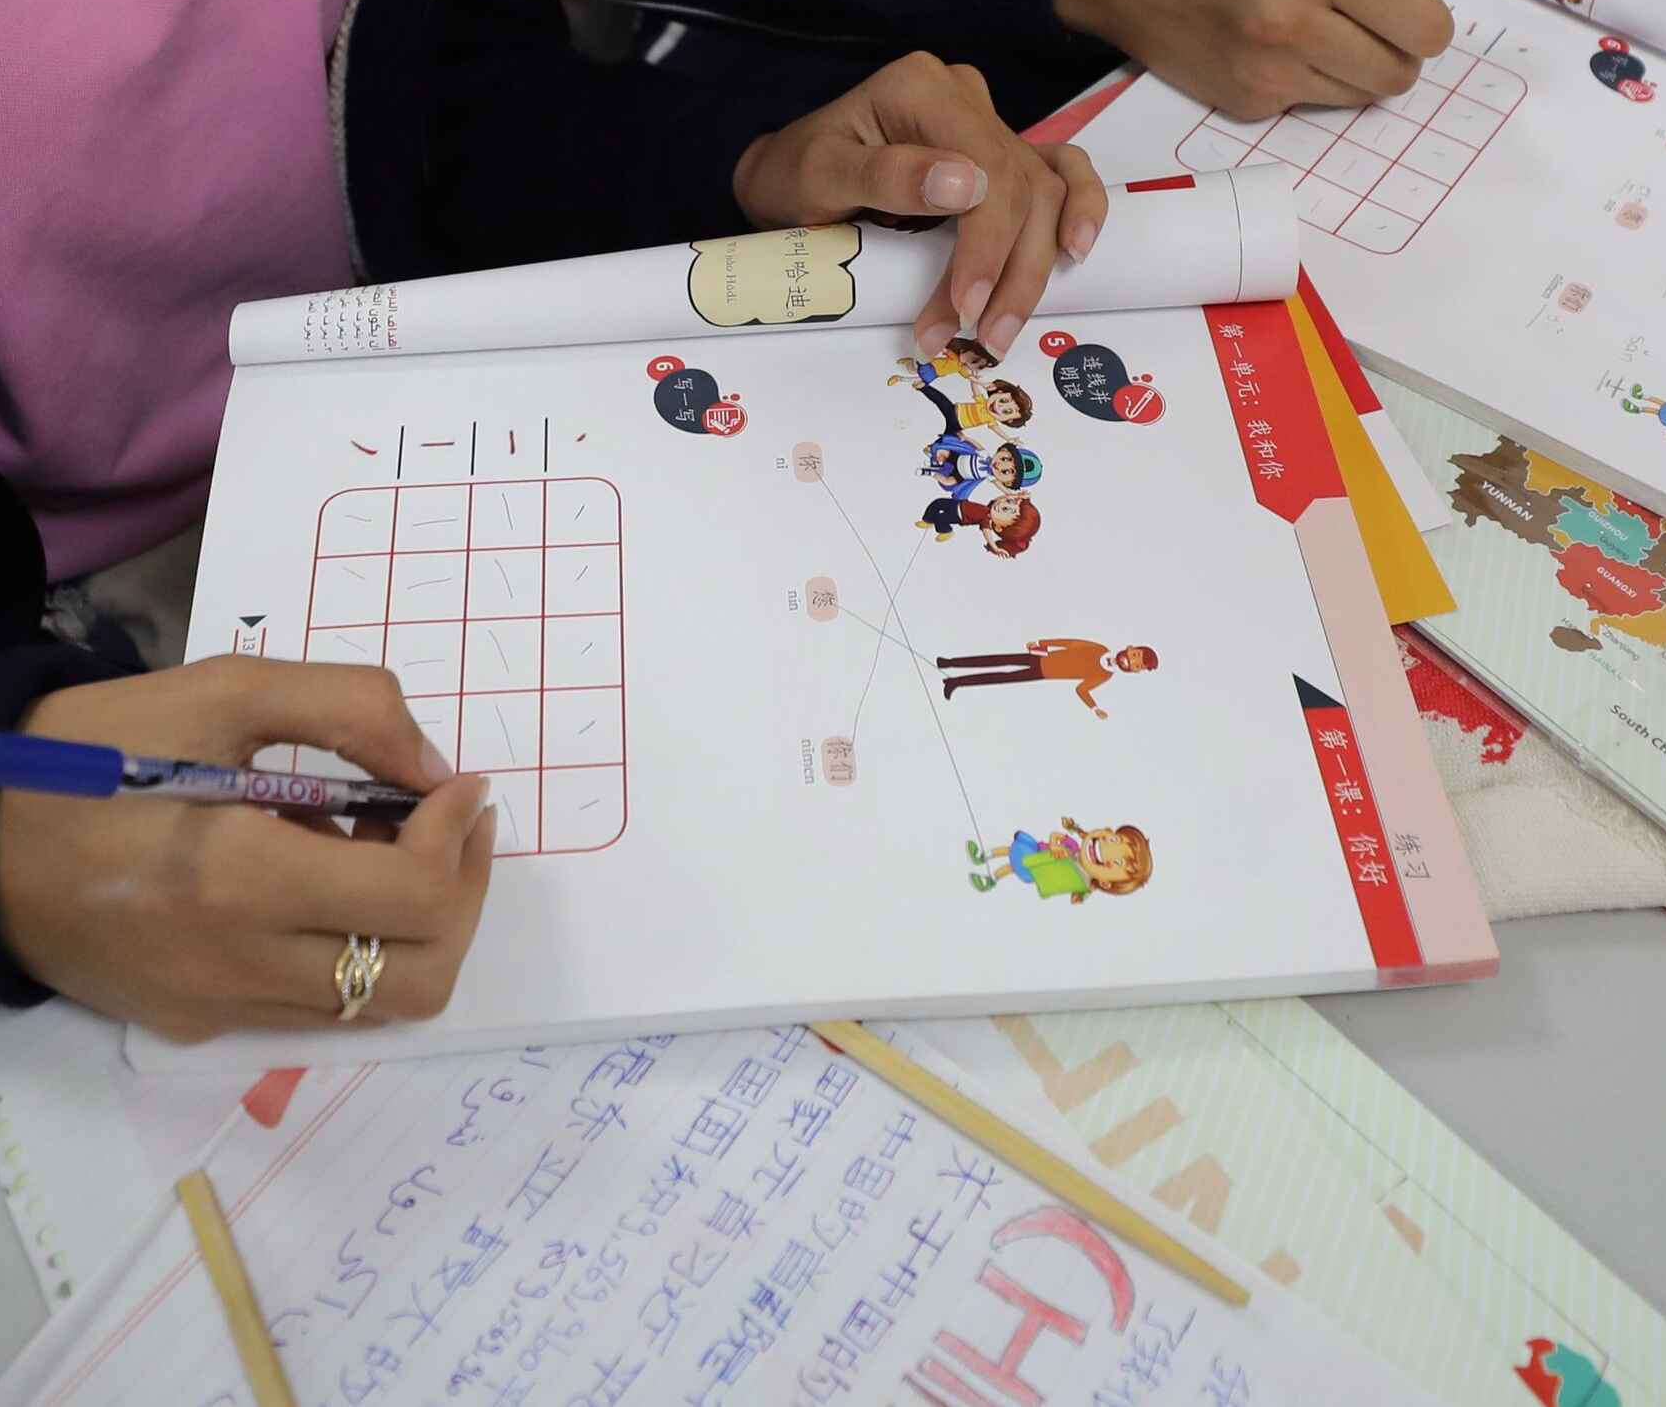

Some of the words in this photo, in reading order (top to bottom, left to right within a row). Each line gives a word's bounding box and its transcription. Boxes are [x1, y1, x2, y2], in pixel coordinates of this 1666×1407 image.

[1046, 335, 1065, 348] 5
[655, 360, 673, 371] 6
[670, 376, 697, 423] 写一写
[1215, 322, 1283, 482] 第一单元：我和你
[1482, 481, 1533, 521] YUNNAN
[1588, 510, 1628, 542] GUIZHOU
[1597, 567, 1637, 598] GUANGXI
[241, 636, 256, 651] 13
[1610, 704, 1650, 739] South
[1315, 728, 1389, 887] 第一课：你好
[1394, 831, 1432, 883] 练习
